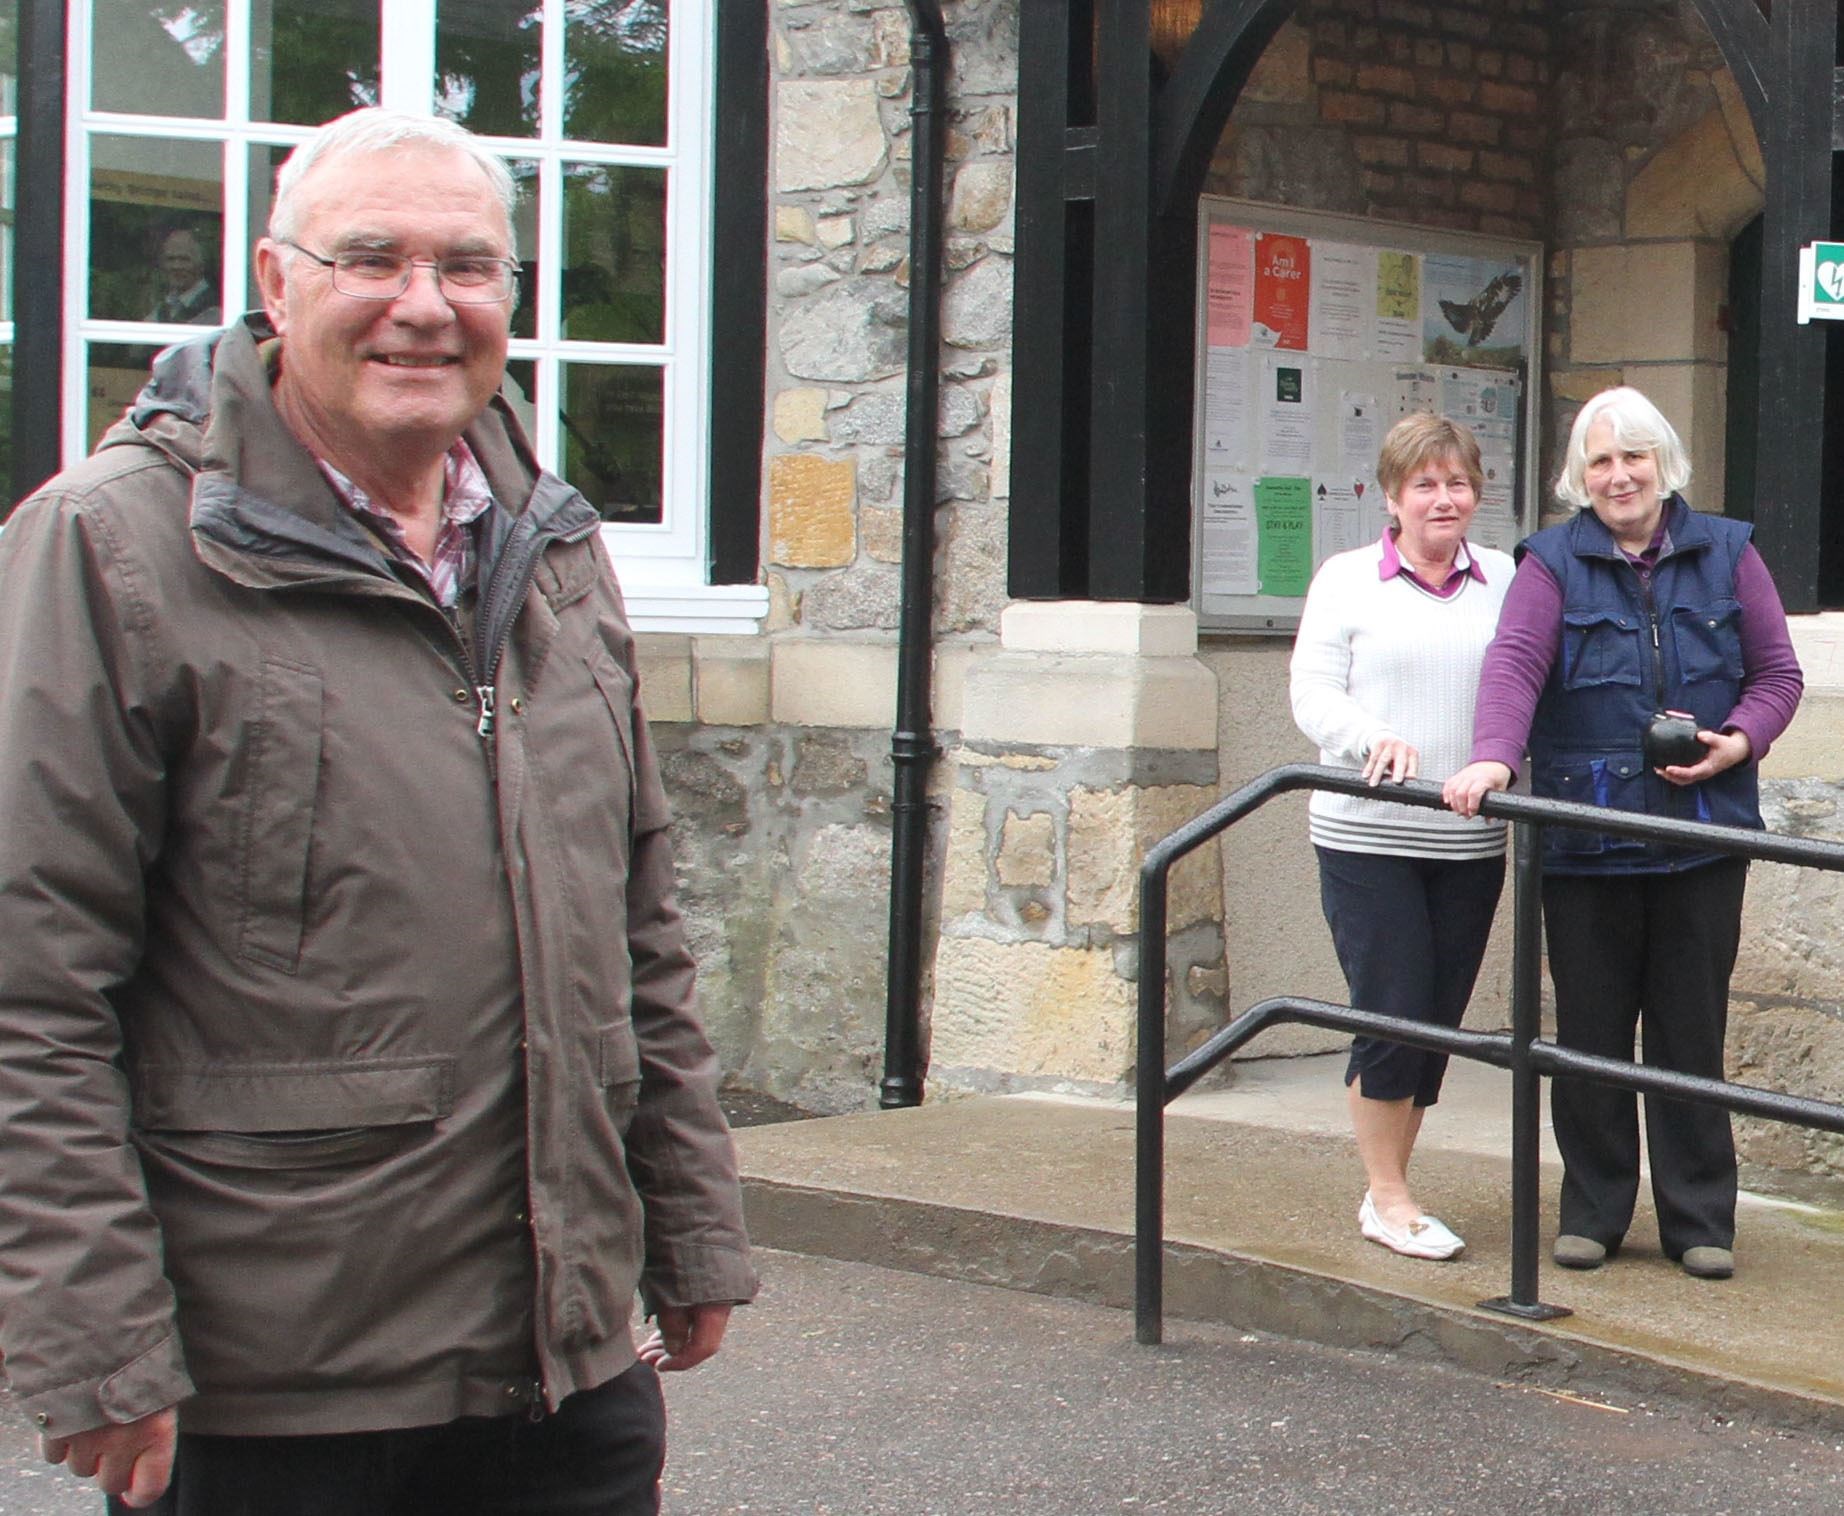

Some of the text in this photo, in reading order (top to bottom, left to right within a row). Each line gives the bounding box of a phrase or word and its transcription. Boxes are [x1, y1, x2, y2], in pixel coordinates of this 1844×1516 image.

[1271, 255, 1289, 267] Am
[1263, 267, 1271, 276] a
[1272, 266, 1302, 280] Carer
